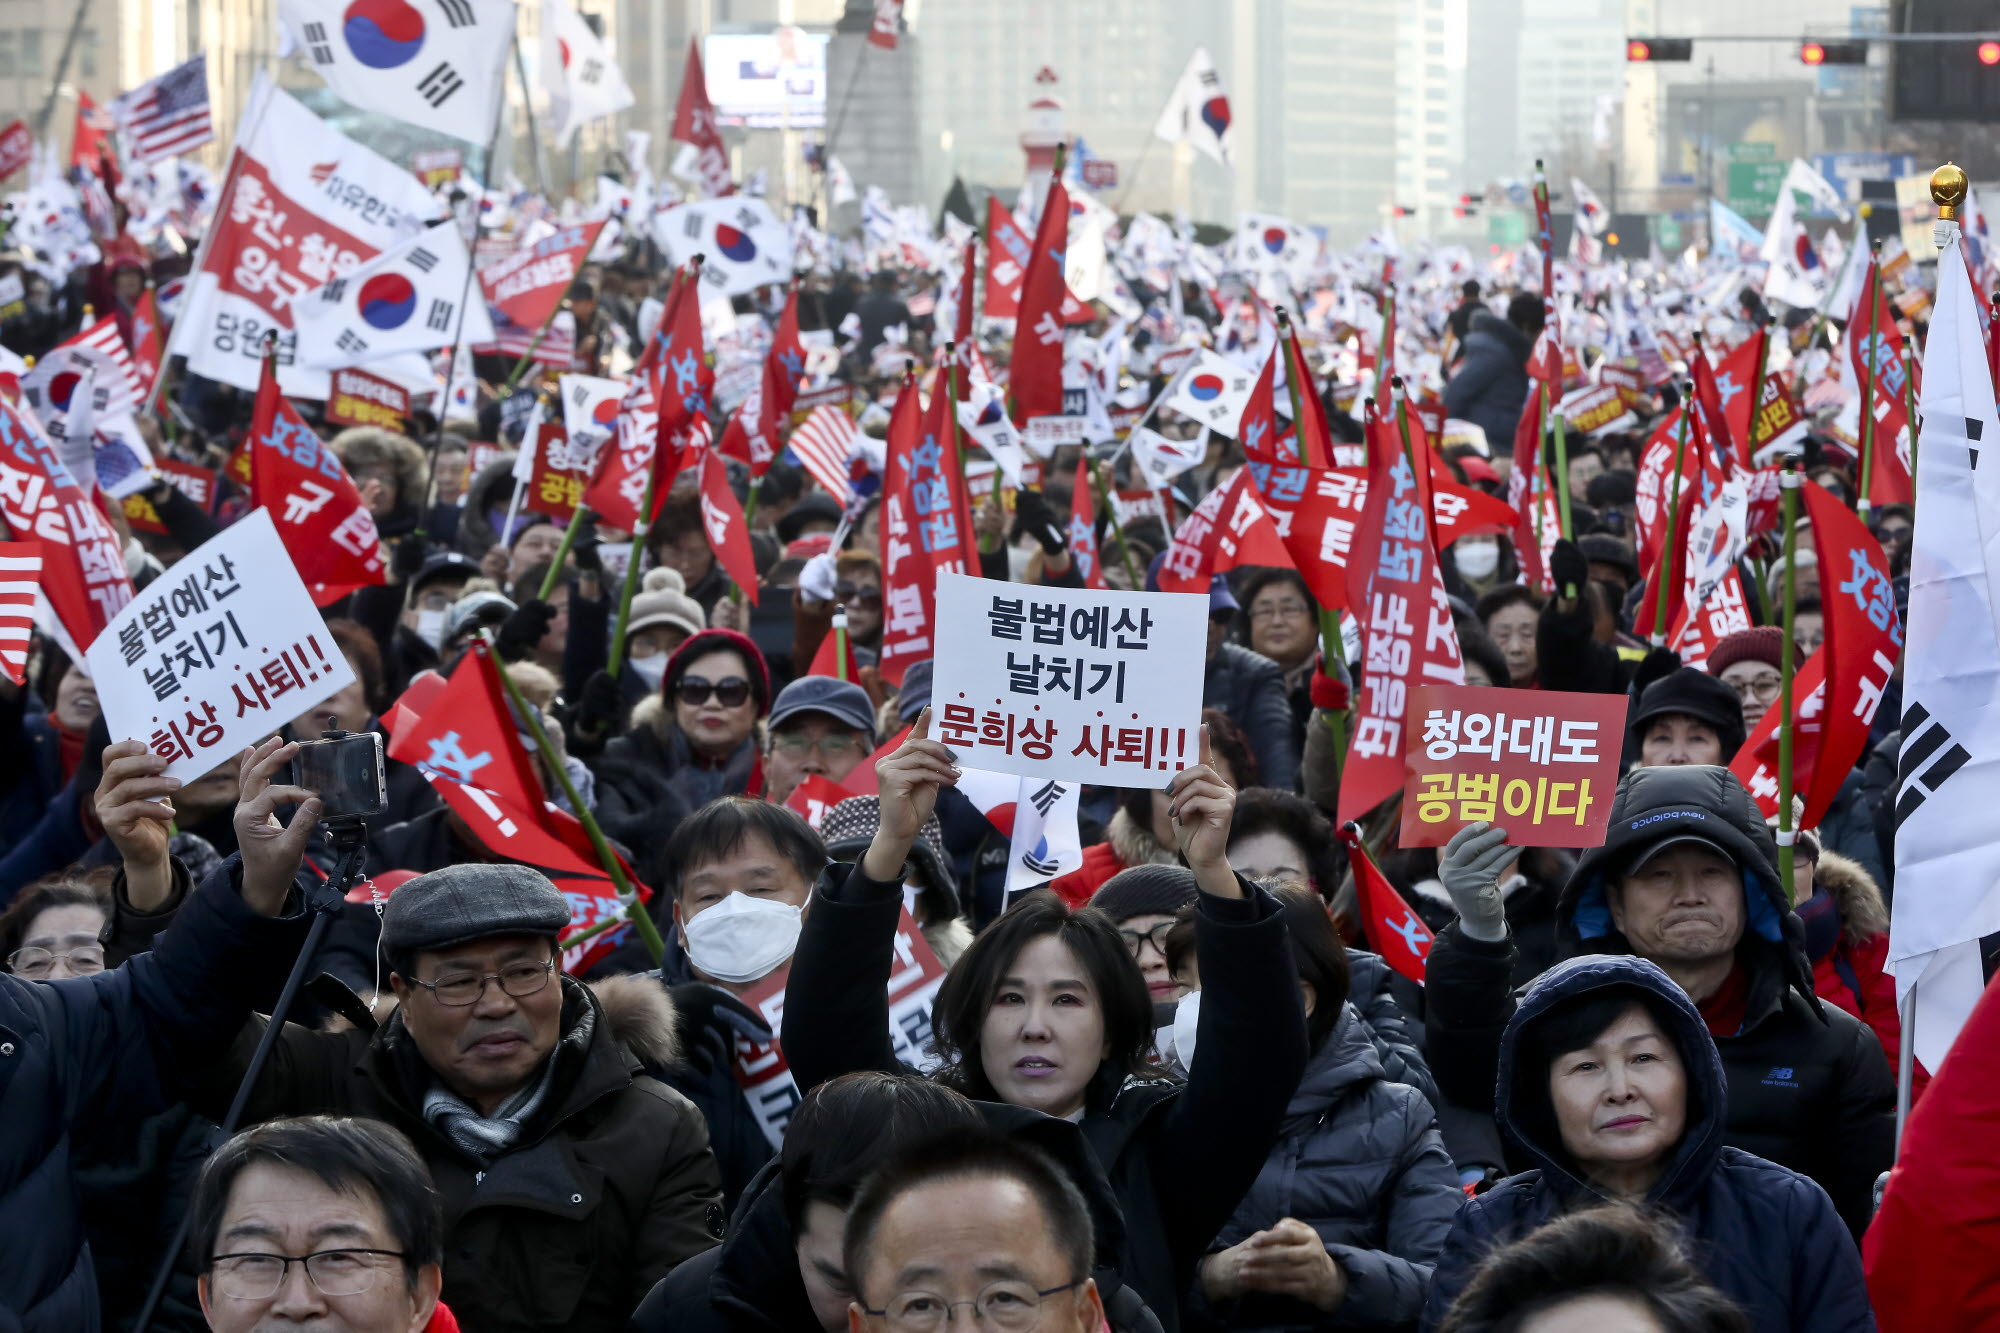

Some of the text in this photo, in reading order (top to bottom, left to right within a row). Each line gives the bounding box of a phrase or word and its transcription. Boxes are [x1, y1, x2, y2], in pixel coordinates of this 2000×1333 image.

[118, 553, 241, 667] 불법예산
[987, 595, 1153, 651] 불법예산
[143, 612, 249, 702] 날치기
[1006, 652, 1127, 704] 날치기
[149, 635, 334, 765] 희상 사퇴!!
[939, 703, 1186, 772] 문희상 사퇴!!
[1423, 709, 1600, 764] 청와대도
[1417, 772, 1594, 826] 공범이다
